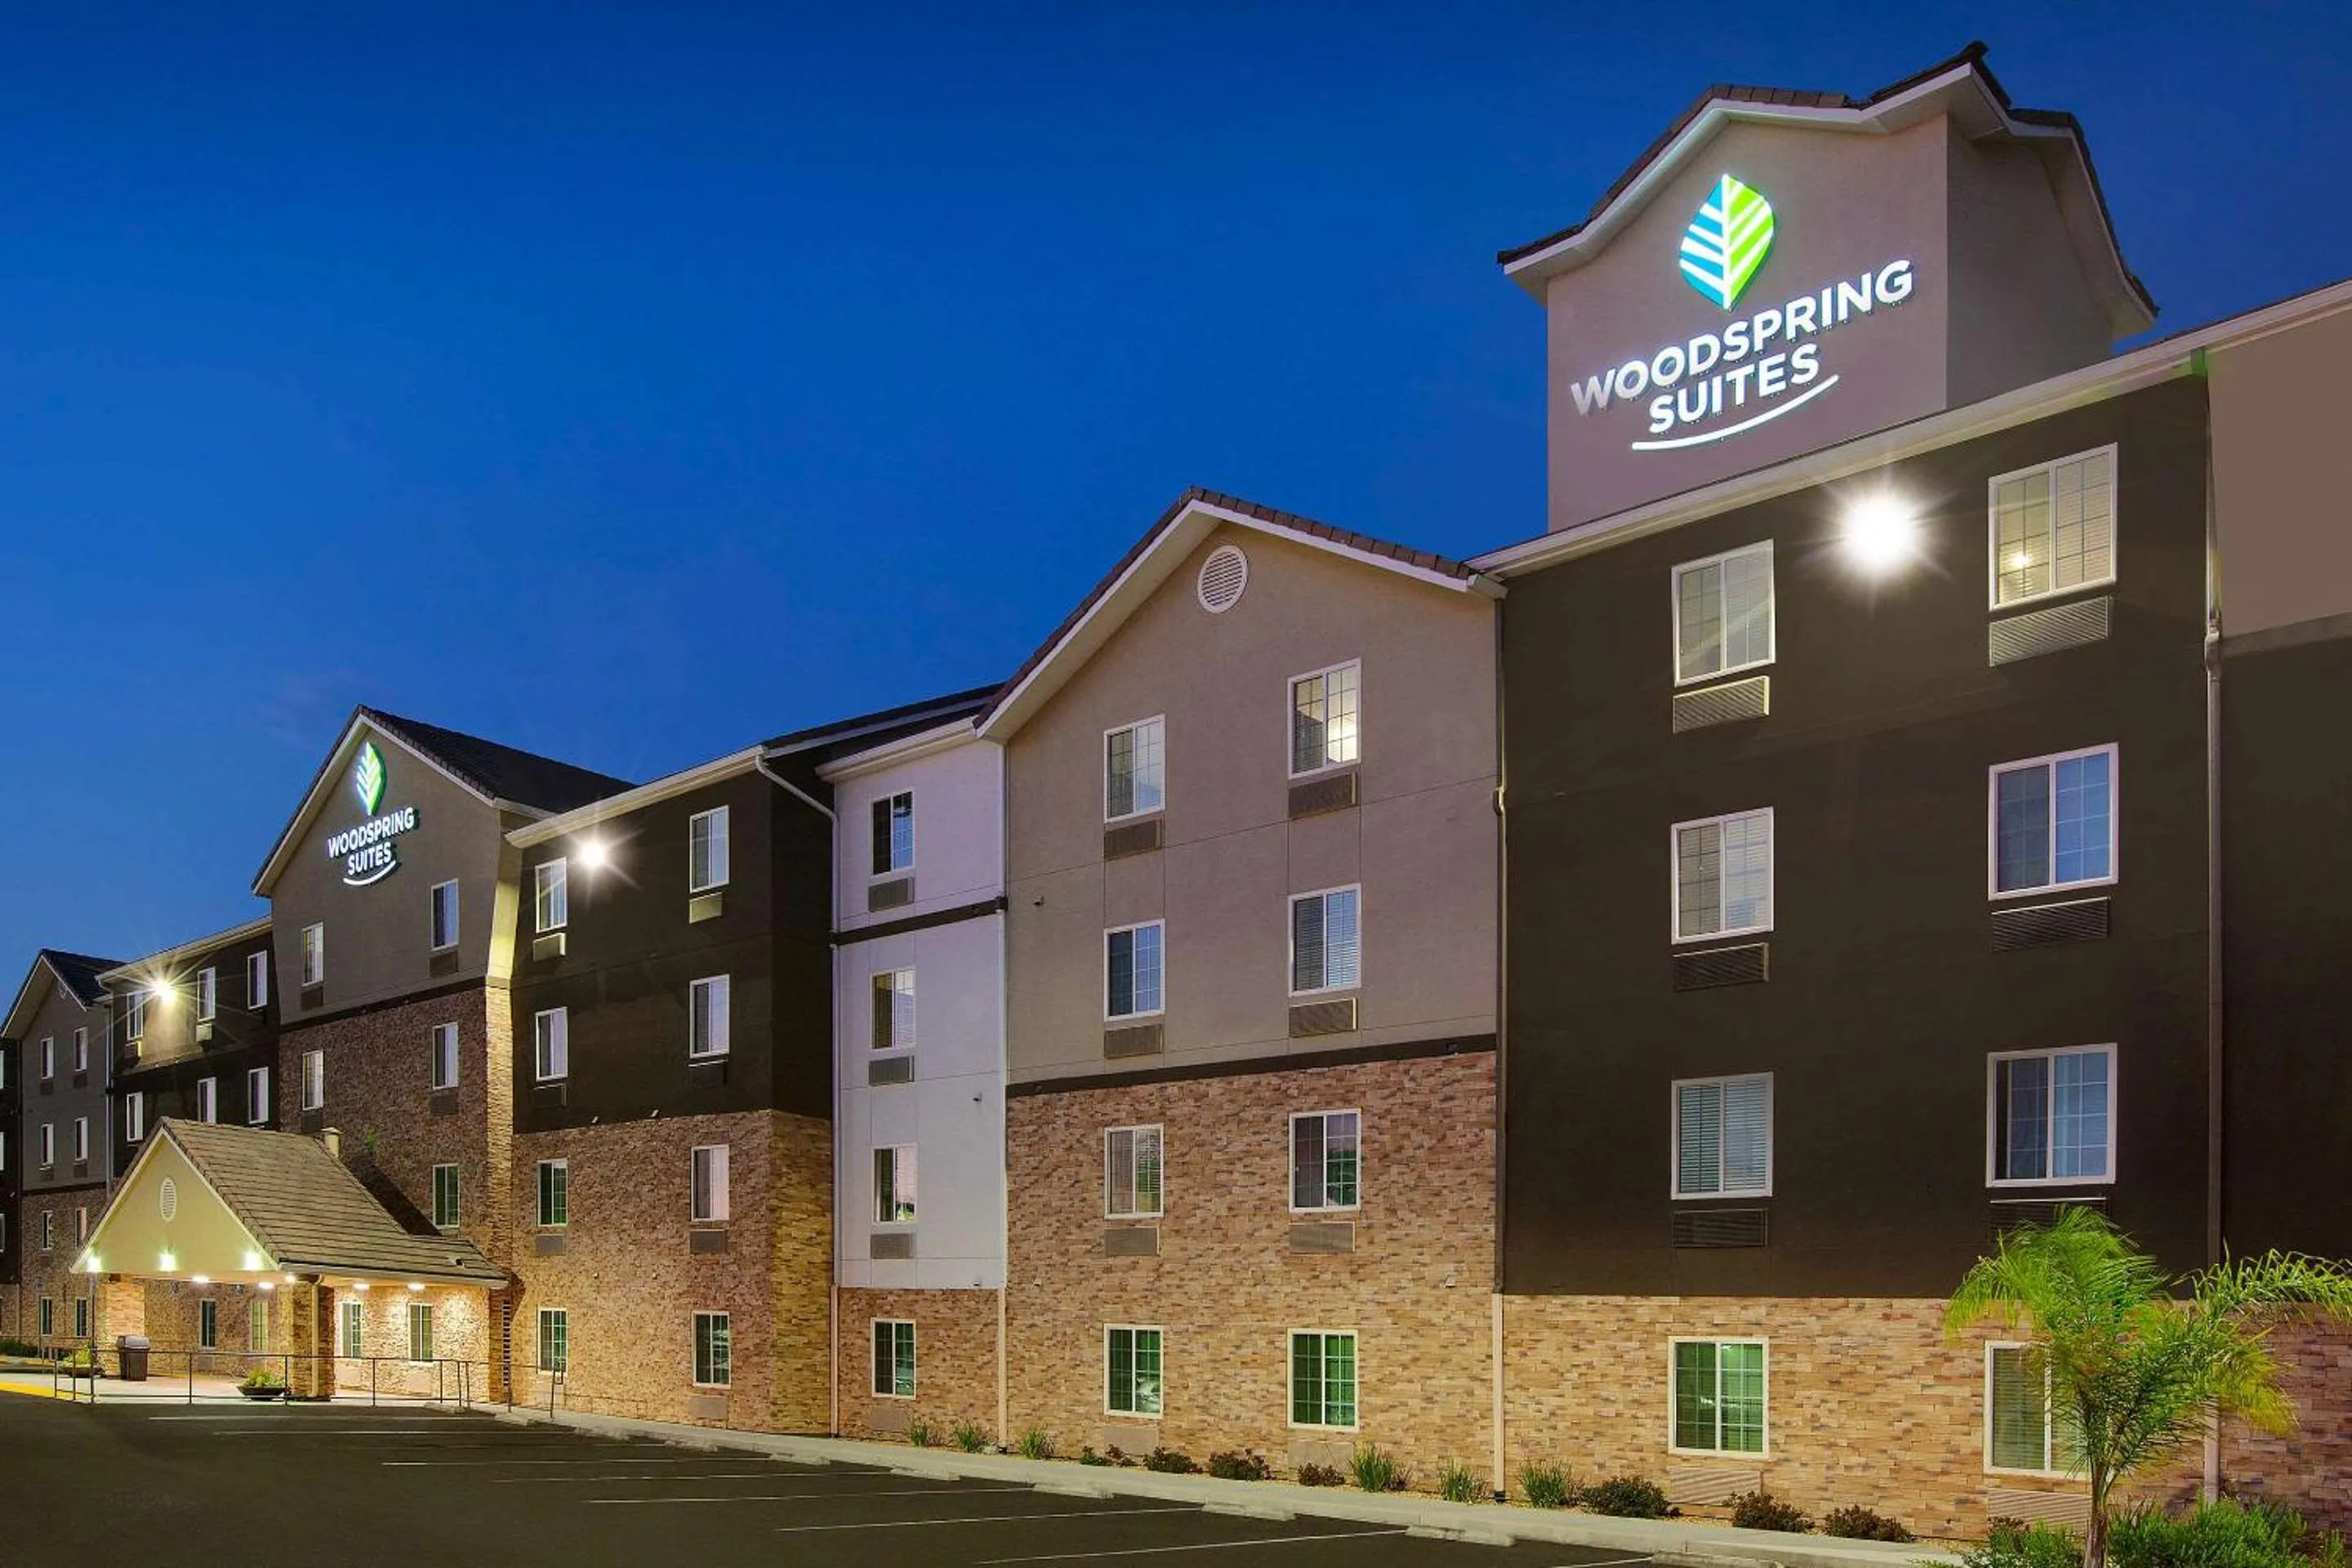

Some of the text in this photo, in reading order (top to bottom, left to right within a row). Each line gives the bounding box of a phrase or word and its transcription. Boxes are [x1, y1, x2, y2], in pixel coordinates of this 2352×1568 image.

[1570, 259, 1914, 416] WOODSPRING
[1648, 343, 1820, 434] SUITES
[327, 806, 416, 858] WOODSPRING
[347, 841, 392, 875] SUITES
